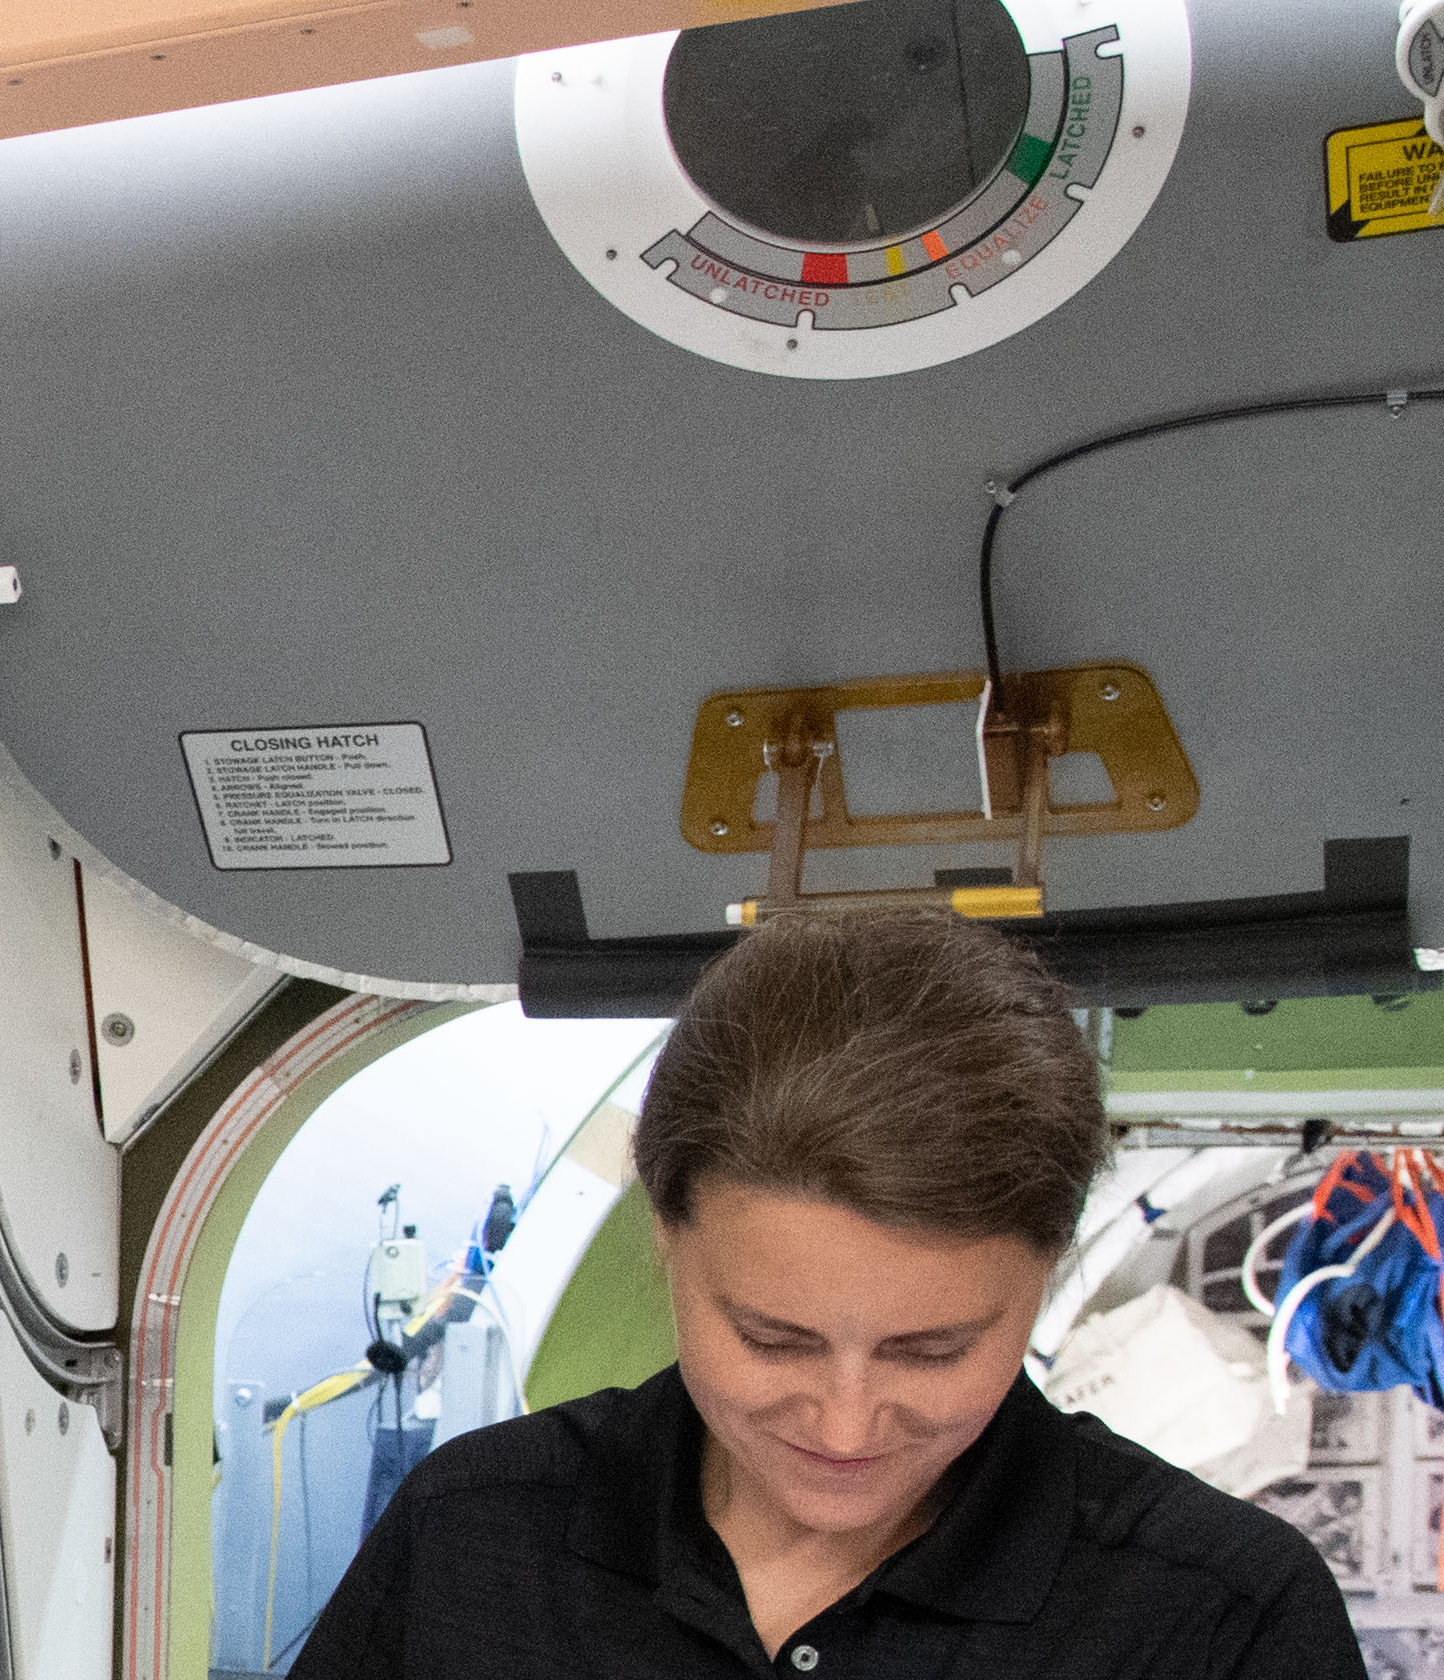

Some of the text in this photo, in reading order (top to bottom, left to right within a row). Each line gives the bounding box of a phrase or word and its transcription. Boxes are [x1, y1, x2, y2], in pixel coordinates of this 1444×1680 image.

[1051, 73, 1093, 182] LATCHED
[1359, 165, 1414, 182] FAILURE
[1418, 162, 1436, 173] TO
[1359, 175, 1413, 193] BEFORE
[1359, 186, 1410, 204] RESULT
[1359, 196, 1431, 213] EQUIPMEN
[944, 194, 1051, 281] EQUALIZE
[689, 253, 832, 310] UNLATCHED
[230, 733, 379, 752] CLOSING HATCH
[214, 757, 258, 766] STOWAGE
[262, 755, 292, 764] LATCH
[295, 754, 333, 763] BUTTON
[216, 766, 261, 775] STOWAGE
[264, 764, 294, 773] LATCH
[297, 762, 336, 771] HANDLE
[219, 775, 249, 783] HATCH
[220, 783, 261, 792] ARROWS
[346, 788, 374, 796] VALVE
[275, 799, 305, 807] LATCH
[228, 810, 259, 818] CRANK
[262, 808, 299, 817] HANDLE
[230, 818, 261, 826] CRANK
[343, 814, 373, 823] LATCH
